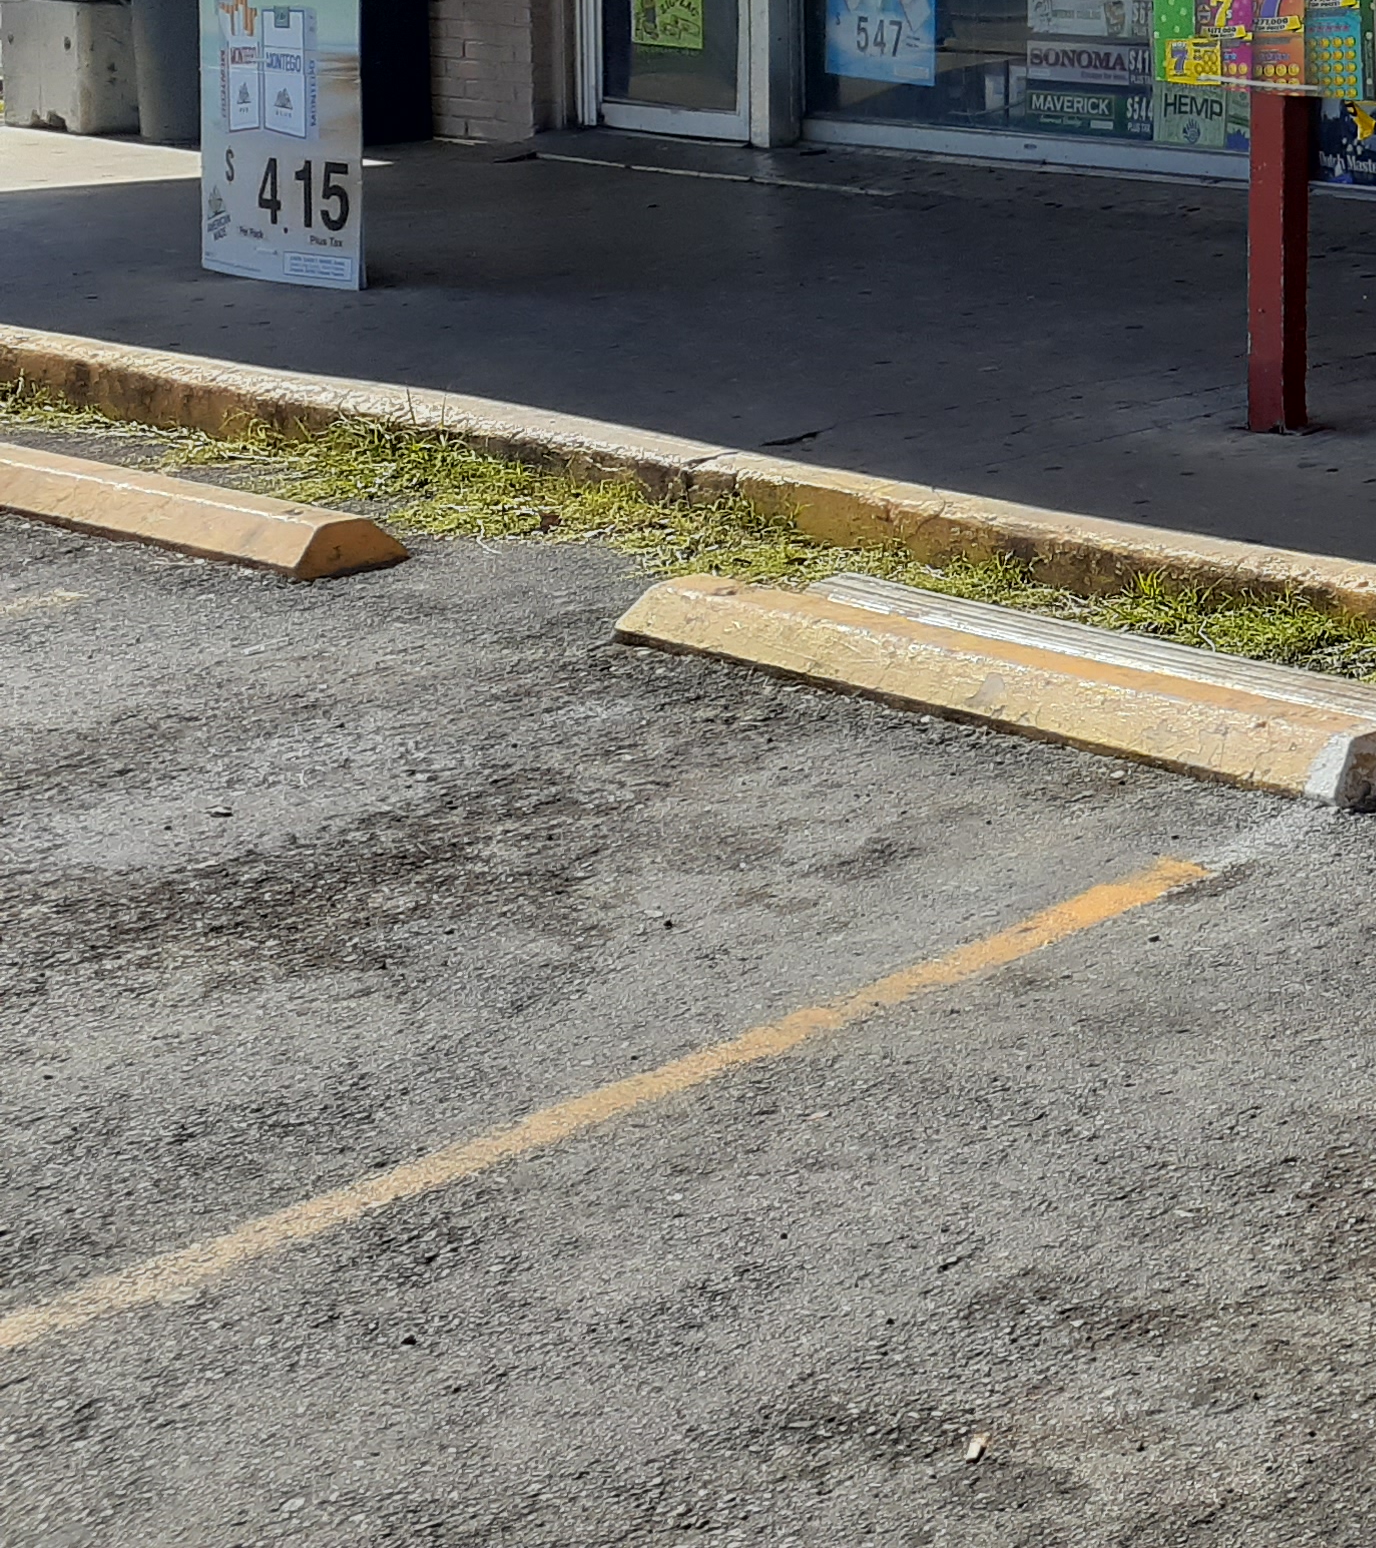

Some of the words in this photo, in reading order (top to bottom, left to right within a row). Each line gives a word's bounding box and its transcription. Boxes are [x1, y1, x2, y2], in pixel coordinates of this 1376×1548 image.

[1030, 48, 1127, 72] SONOMA
[1031, 94, 1110, 115] MAVERICK
[1163, 93, 1223, 121] HEMP
